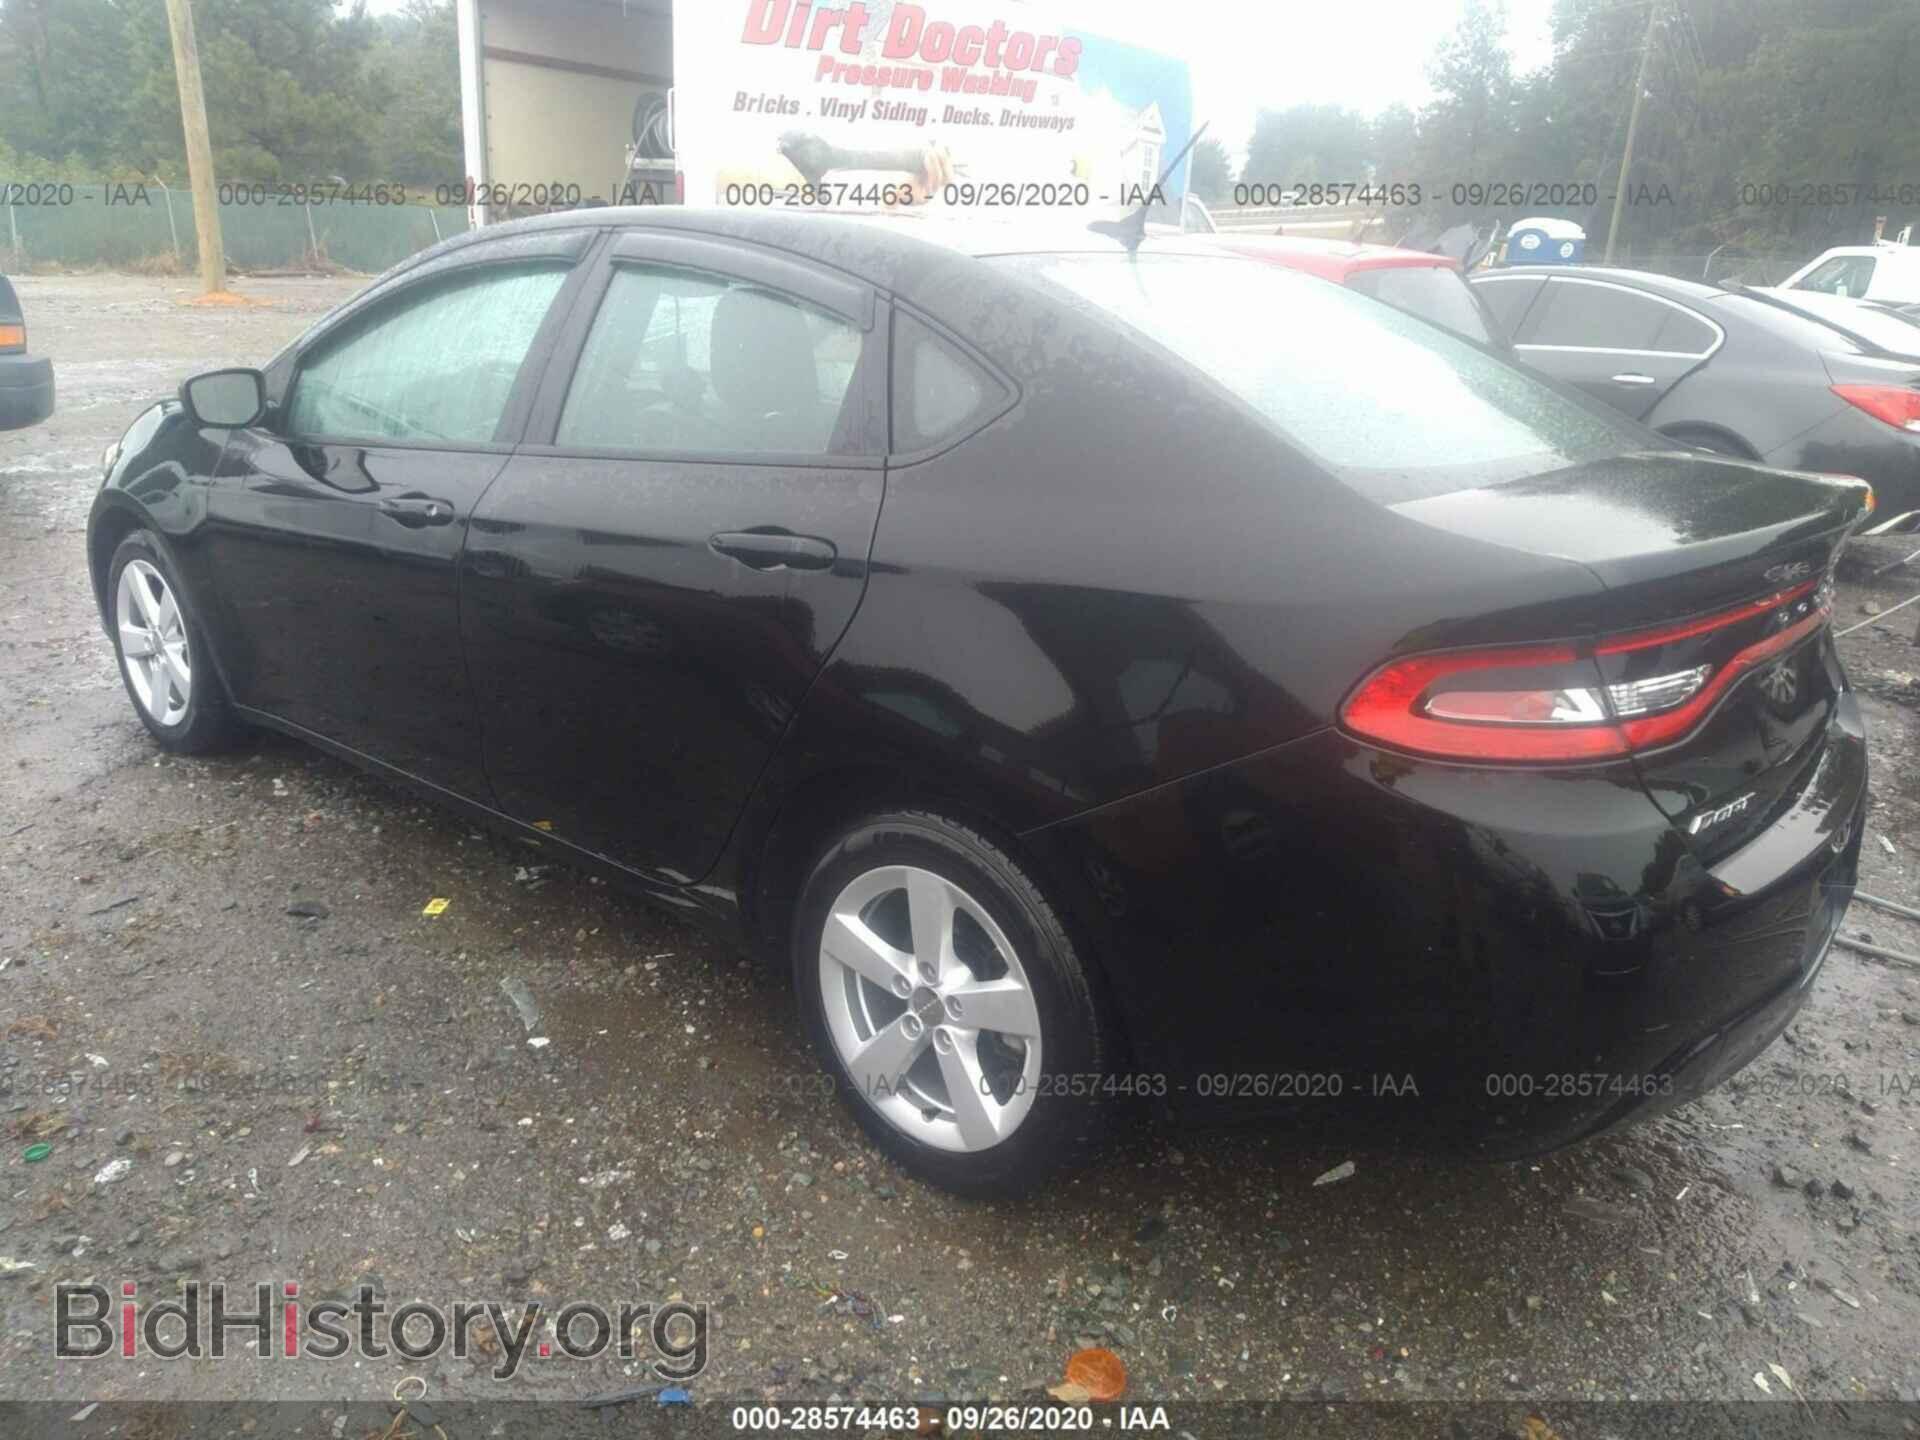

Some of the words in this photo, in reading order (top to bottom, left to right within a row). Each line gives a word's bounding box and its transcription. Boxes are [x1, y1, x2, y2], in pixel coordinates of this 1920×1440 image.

[741, 0, 869, 55] Dirt
[881, 2, 1084, 76] Doctors
[814, 54, 935, 91] Pressure
[940, 67, 1038, 103] Washing
[733, 91, 801, 117] Bricks
[820, 97, 867, 123] Vinyl
[872, 100, 928, 127] Siding
[999, 109, 1075, 133] Driveways
